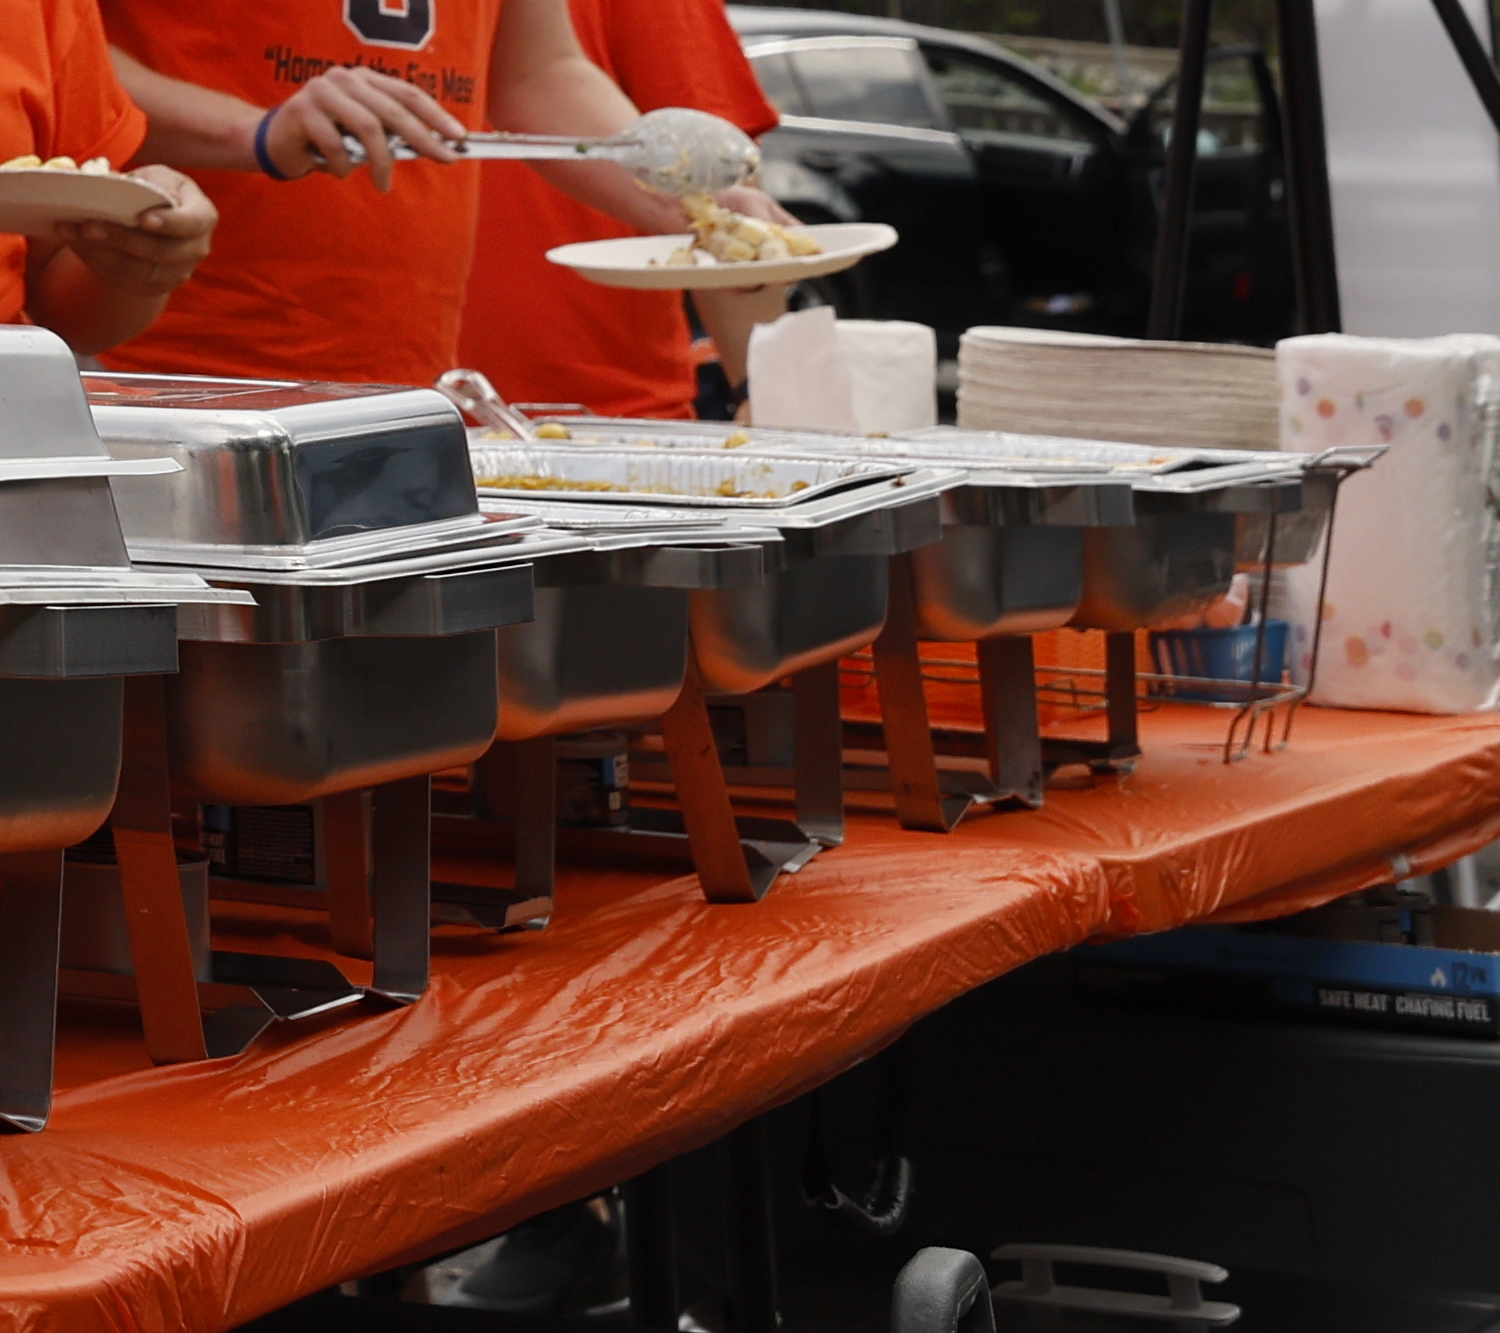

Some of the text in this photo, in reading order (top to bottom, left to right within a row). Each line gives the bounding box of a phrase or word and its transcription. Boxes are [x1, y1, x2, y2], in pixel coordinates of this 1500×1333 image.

[1318, 988, 1352, 1009] SAFE
[1395, 995, 1455, 1020] CHAFING
[1457, 1000, 1491, 1024] FUEL
